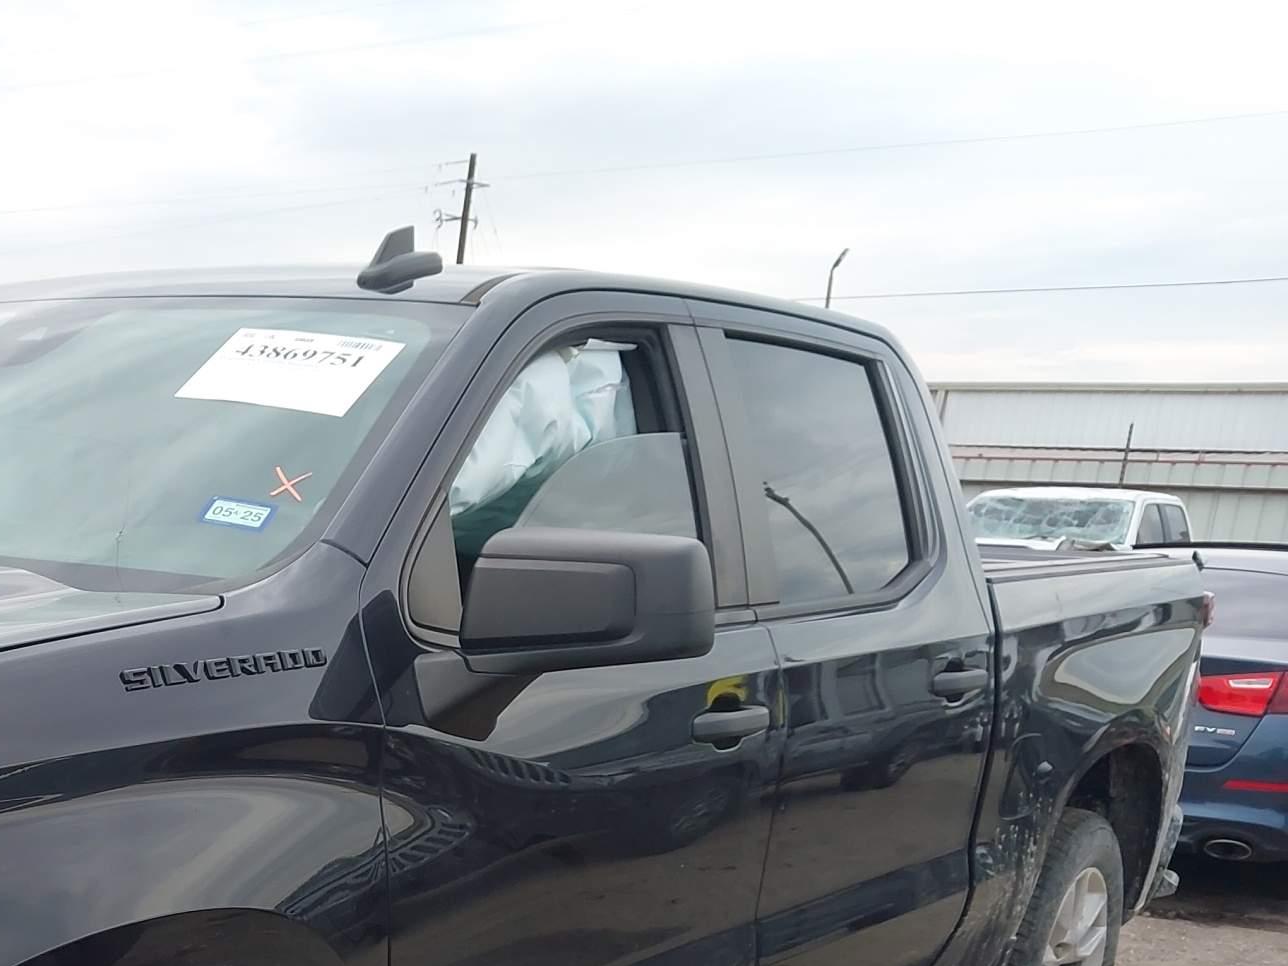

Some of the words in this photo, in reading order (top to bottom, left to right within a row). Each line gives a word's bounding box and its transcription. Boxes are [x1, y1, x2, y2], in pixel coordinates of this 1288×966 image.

[235, 343, 365, 368] 43869751
[211, 505, 235, 518] 05
[239, 510, 264, 523] 25
[120, 646, 328, 693] SILVERADO
